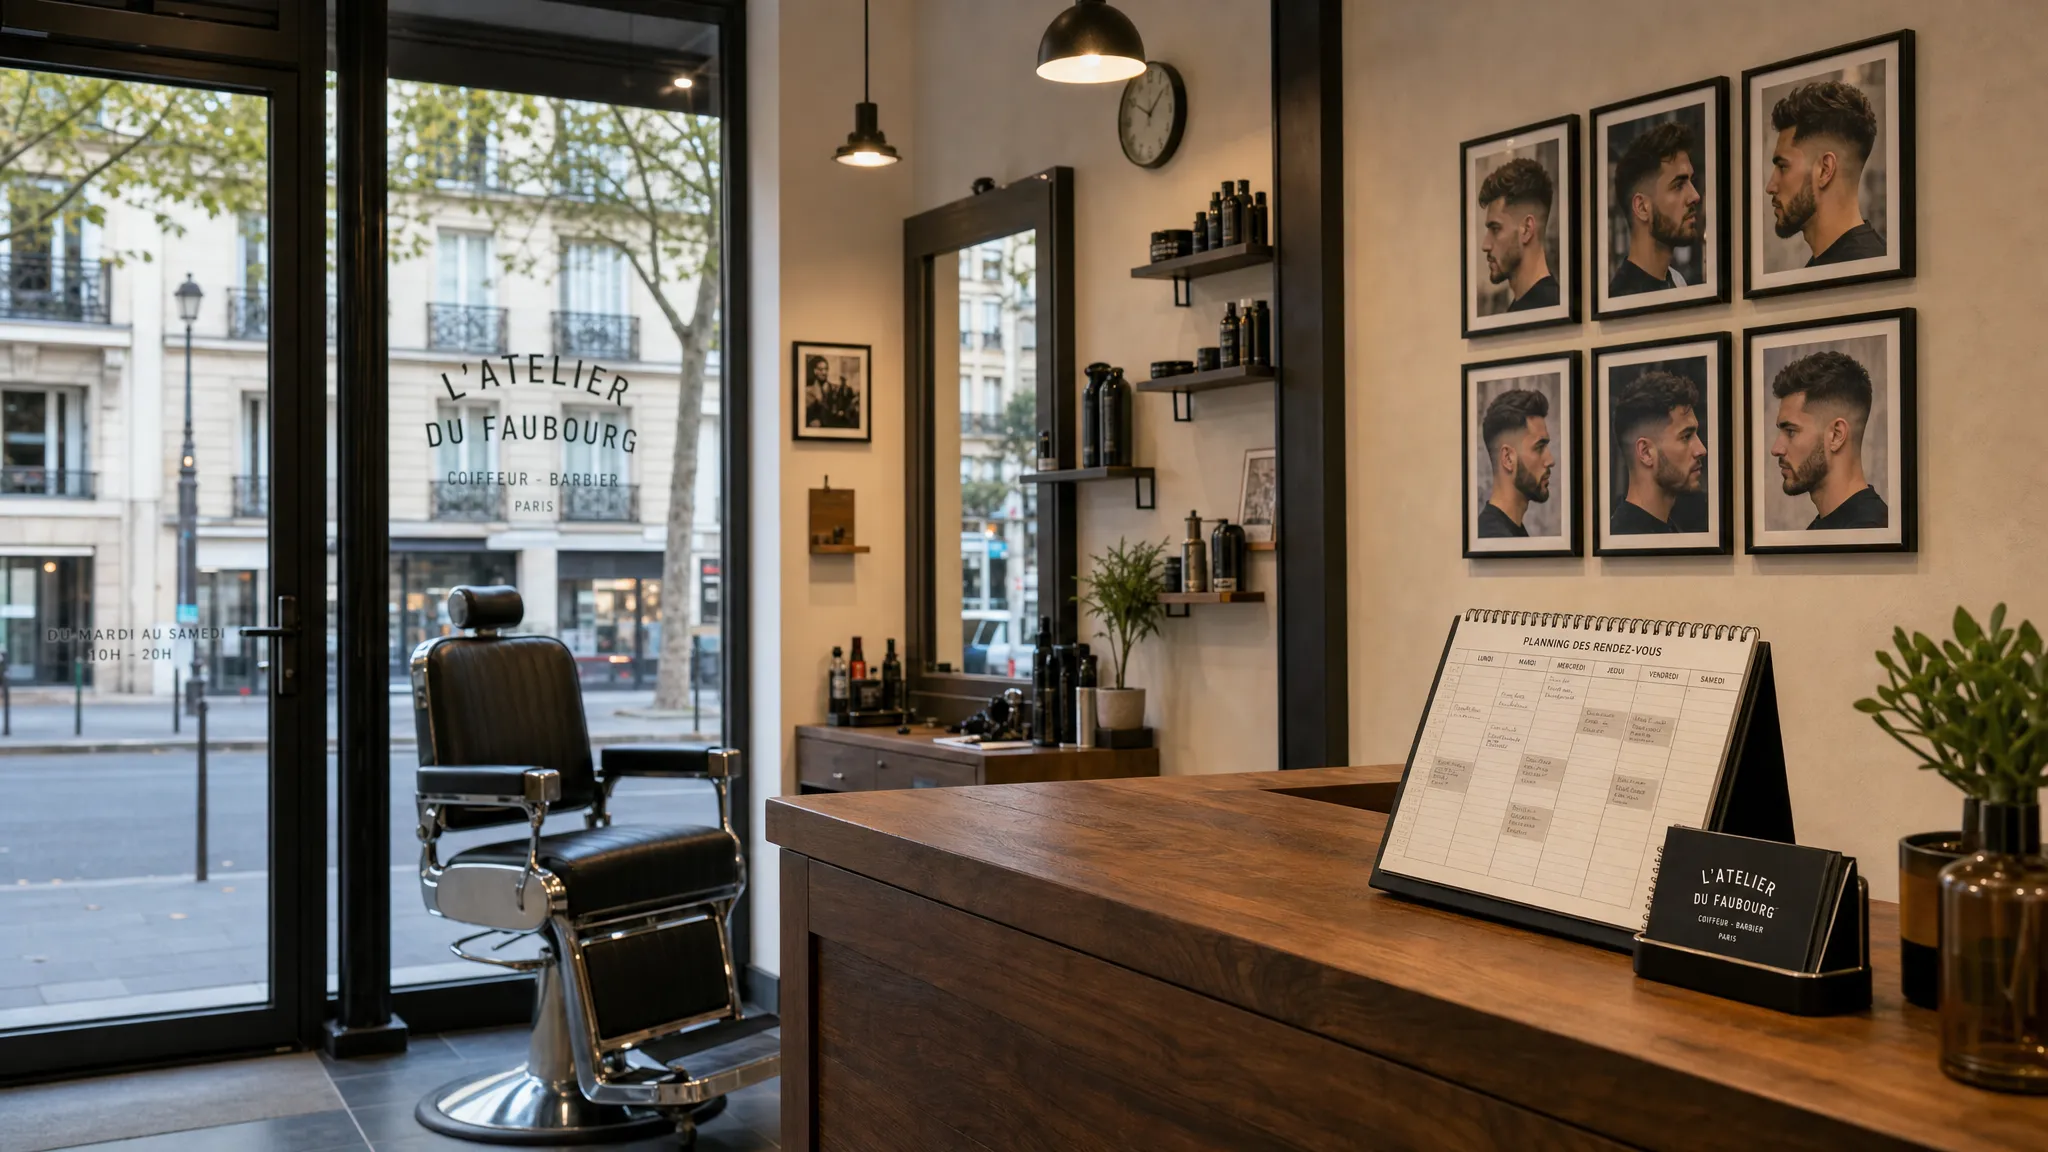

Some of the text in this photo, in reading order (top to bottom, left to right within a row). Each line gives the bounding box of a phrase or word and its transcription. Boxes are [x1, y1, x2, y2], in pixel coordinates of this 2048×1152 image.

[441, 353, 629, 406] L'ATELIER
[425, 414, 638, 454] DU FAUBOURG
[447, 470, 528, 486] COIFFEUR
[549, 472, 619, 487] BARBIER
[514, 500, 554, 512] PARIS
[47, 627, 226, 642] DU MARDI AU SAMEDI
[89, 648, 121, 662] 10H
[142, 648, 172, 661] 20H
[1522, 636, 1663, 657] PLANNING DES RENDEZ-VOUS
[1700, 676, 1725, 684] SAMEDI
[1701, 868, 1777, 897] L'ATELIER
[1694, 892, 1774, 918] DU FAUBOURG
[1698, 914, 1728, 926] COIFFEUR
[1736, 922, 1764, 933] BARBIER
[1718, 932, 1736, 942] PARIS
